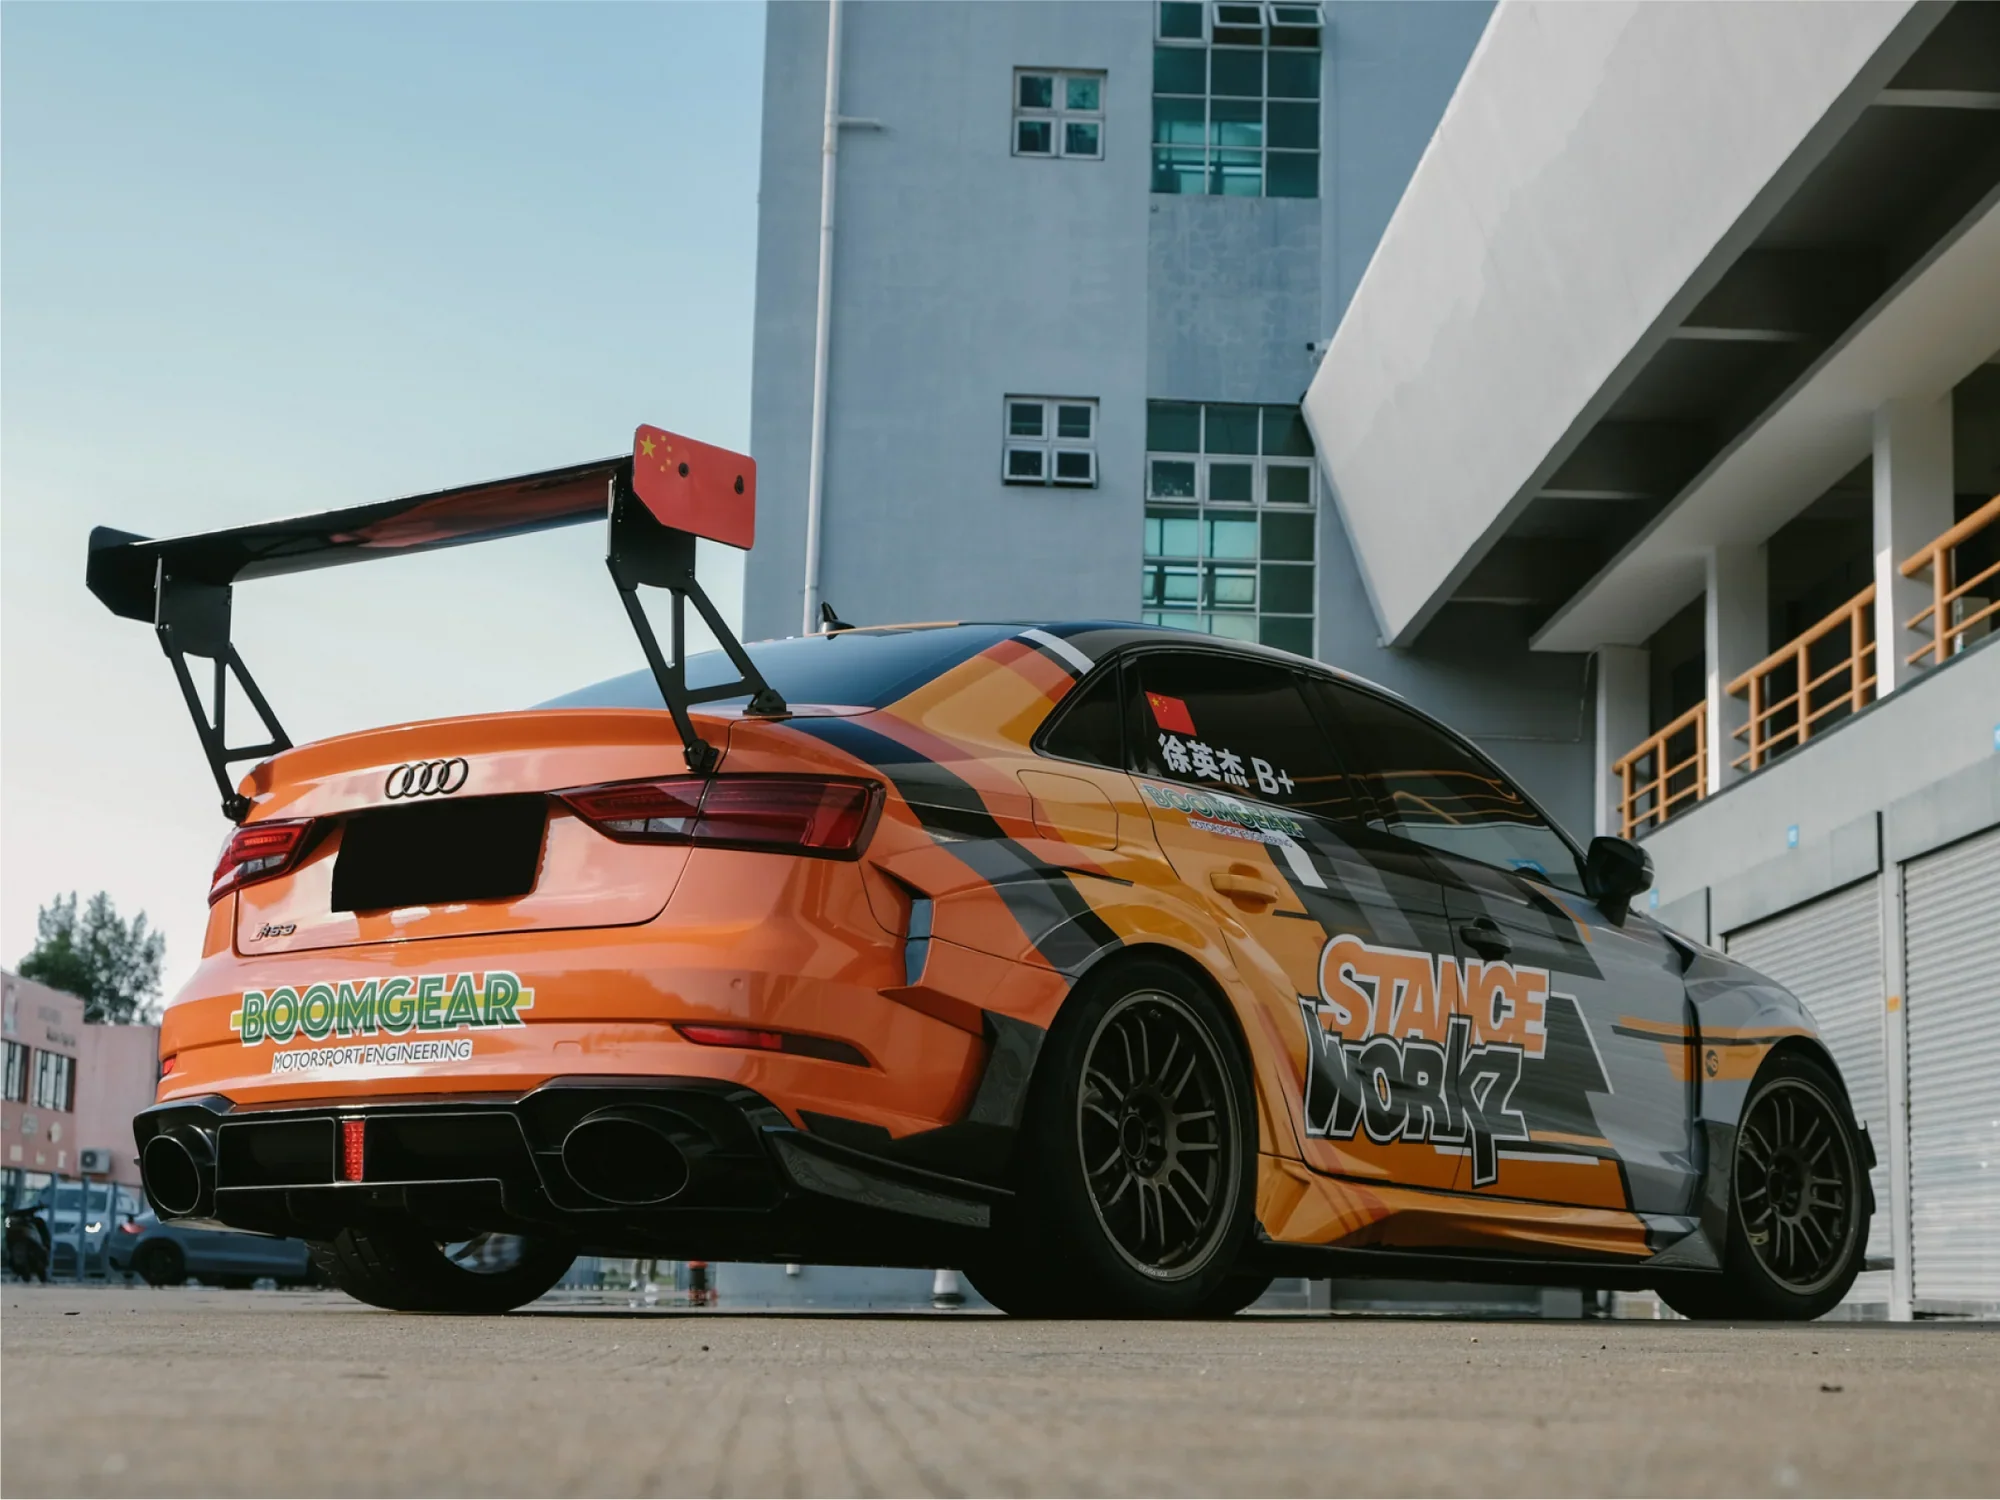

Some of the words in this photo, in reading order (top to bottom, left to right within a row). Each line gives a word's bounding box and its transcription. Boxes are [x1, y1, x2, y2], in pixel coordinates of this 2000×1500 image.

[1158, 732, 1250, 788] 徐英杰
[1250, 757, 1295, 795] B+
[1142, 784, 1304, 838] BOOMGEAR
[241, 971, 525, 1046] BOOMGEAR
[1318, 934, 1550, 1059] STANCE
[272, 1047, 362, 1071] MOTORSPORT
[365, 1041, 471, 1064] ENGINEERING
[1299, 997, 1530, 1188] WORKZ
